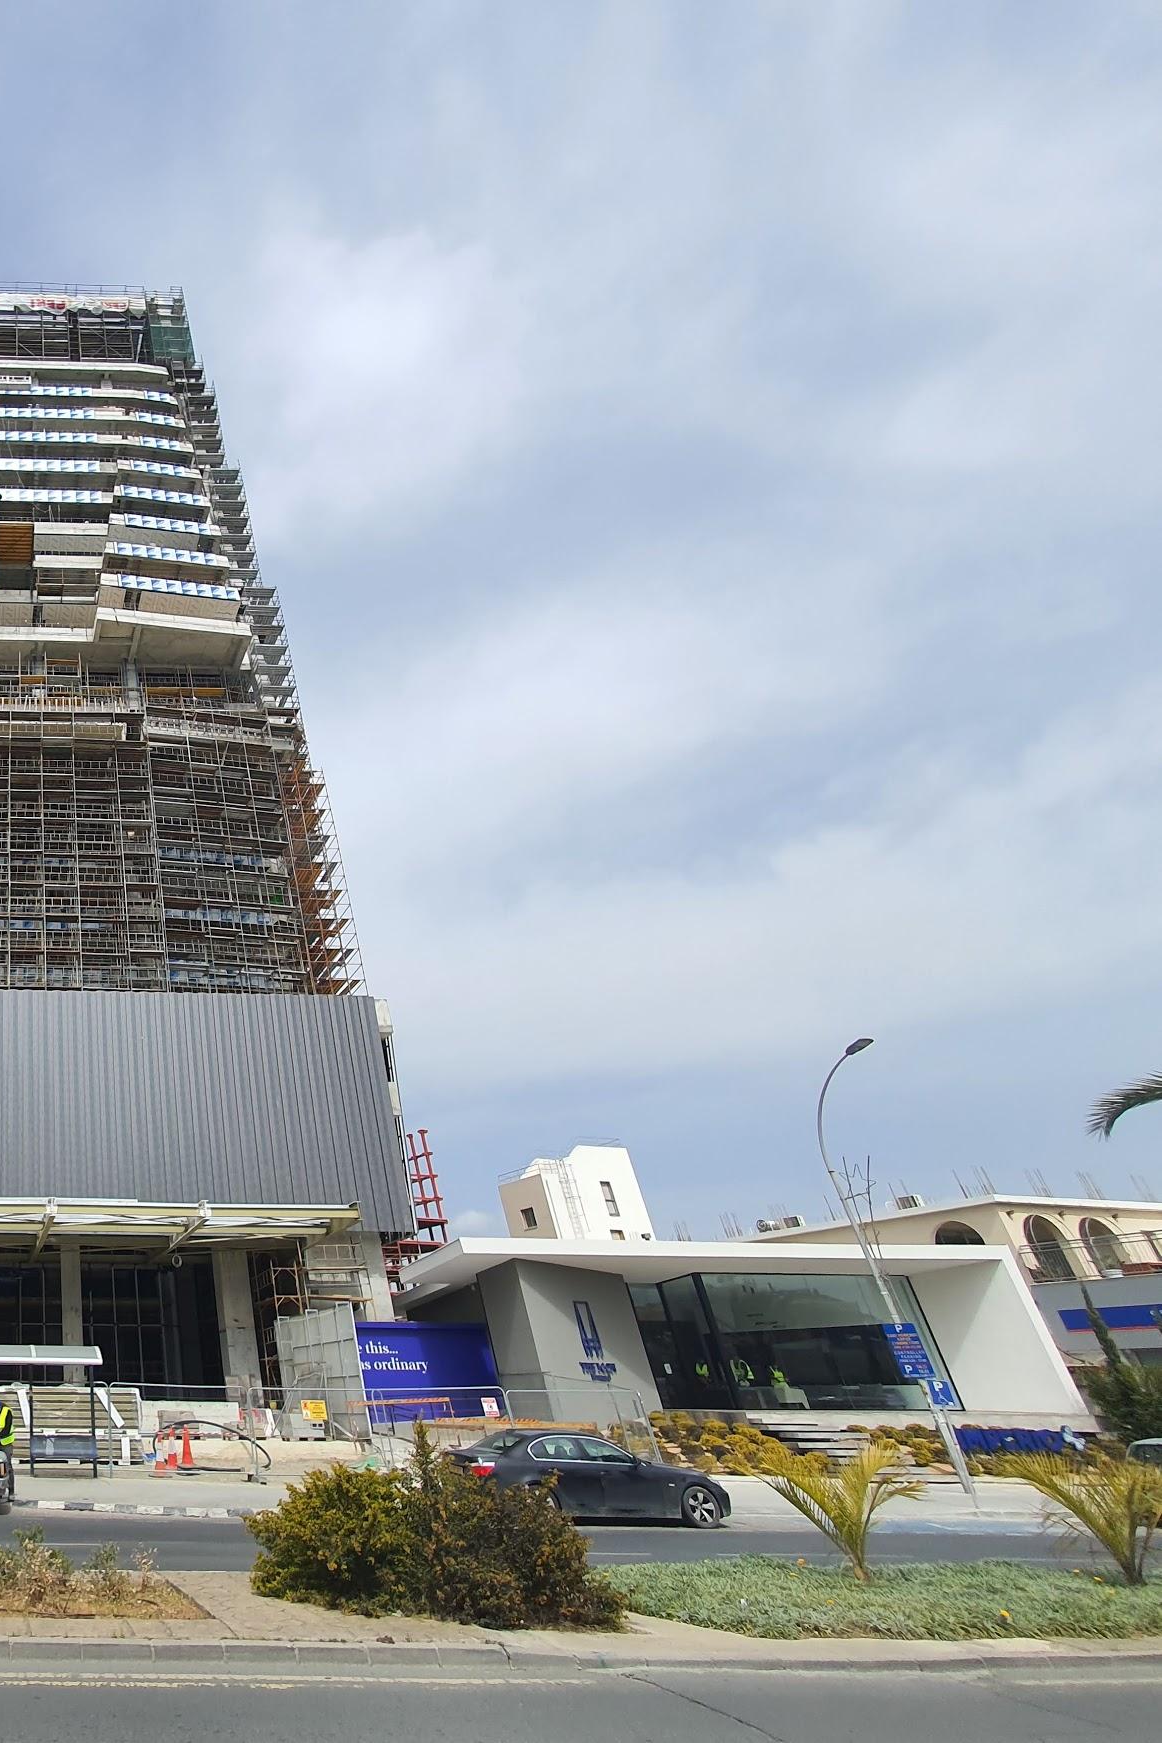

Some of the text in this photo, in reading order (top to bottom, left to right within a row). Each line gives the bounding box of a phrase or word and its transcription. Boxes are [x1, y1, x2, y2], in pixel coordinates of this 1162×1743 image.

[894, 1324, 903, 1333] P
[365, 1340, 399, 1354] this...
[373, 1356, 429, 1374] ordinary
[904, 1364, 913, 1374] P
[932, 1381, 944, 1392] P
